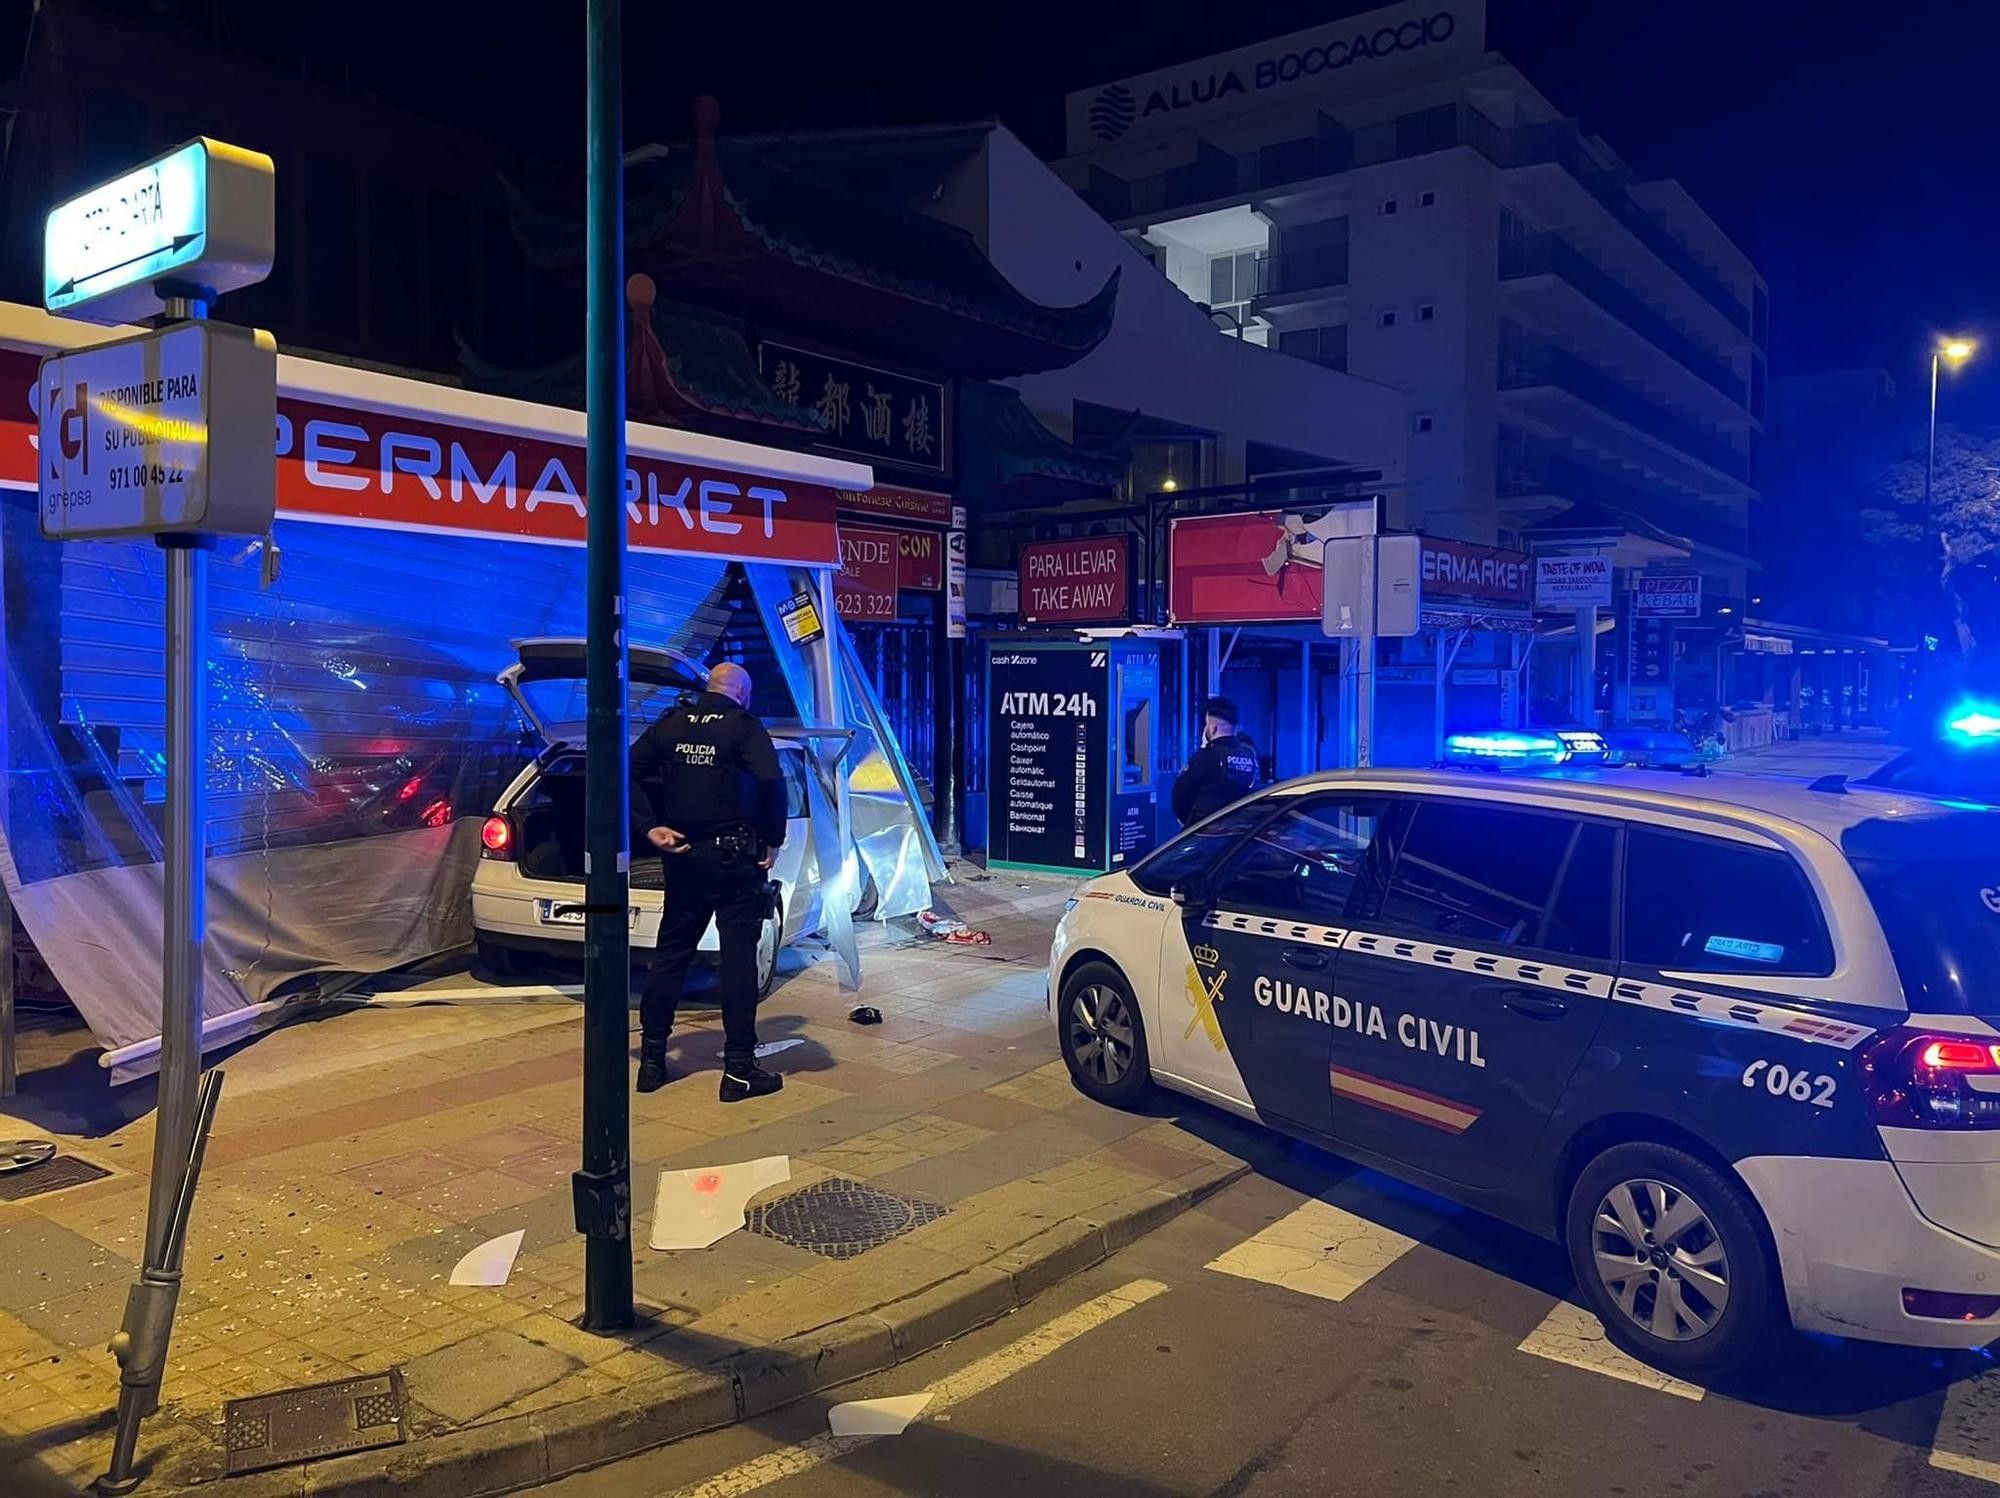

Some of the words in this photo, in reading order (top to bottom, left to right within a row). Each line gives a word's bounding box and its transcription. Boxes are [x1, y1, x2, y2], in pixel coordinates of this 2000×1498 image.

[1142, 71, 1246, 118] ALUA
[1255, 11, 1455, 91] BOCCACCIO
[100, 380, 164, 411] DISPONIBLE
[167, 373, 198, 401] PARA
[105, 428, 120, 451] SU
[123, 418, 190, 449] PUBLICIDAD
[110, 466, 130, 490] 971
[133, 464, 148, 487] 00
[150, 463, 165, 486] 45
[49, 489, 92, 514] grepsa
[1029, 553, 1064, 579] PARA
[1066, 548, 1117, 576] LLEVAR
[1541, 562, 1569, 576] TASTE
[1570, 561, 1582, 575] OF
[1645, 579, 1694, 593] PIZZA
[1032, 586, 1070, 611] TAKE
[1071, 583, 1115, 609] AWAY
[1641, 594, 1696, 608] KEBAB
[835, 594, 862, 614] 623
[867, 595, 893, 615] 322
[992, 655, 1010, 665] cash
[1019, 656, 1037, 665] zone
[1126, 654, 1145, 665] ATM
[1000, 692, 1049, 716] ATM
[1052, 692, 1096, 717] 24h
[1011, 720, 1035, 731] Cajero
[675, 743, 717, 756] POLICIA
[1010, 742, 1047, 753] Cashpoint
[686, 754, 715, 766] LOCAL
[1010, 755, 1033, 765] Caixer
[1227, 755, 1254, 766] POLICIA
[1010, 776, 1056, 788] Geldautomat
[1010, 789, 1034, 799] Caisse
[1010, 800, 1054, 811] automatique
[1009, 810, 1046, 822] Bankomat
[1009, 823, 1045, 834] Банкомат
[1115, 894, 1147, 908] GUARDIA
[1147, 901, 1165, 912] CIVIL
[1253, 974, 1388, 1041] GUARDIA
[1397, 1013, 1487, 1069] CIVIL
[1765, 1063, 1838, 1109] 062
